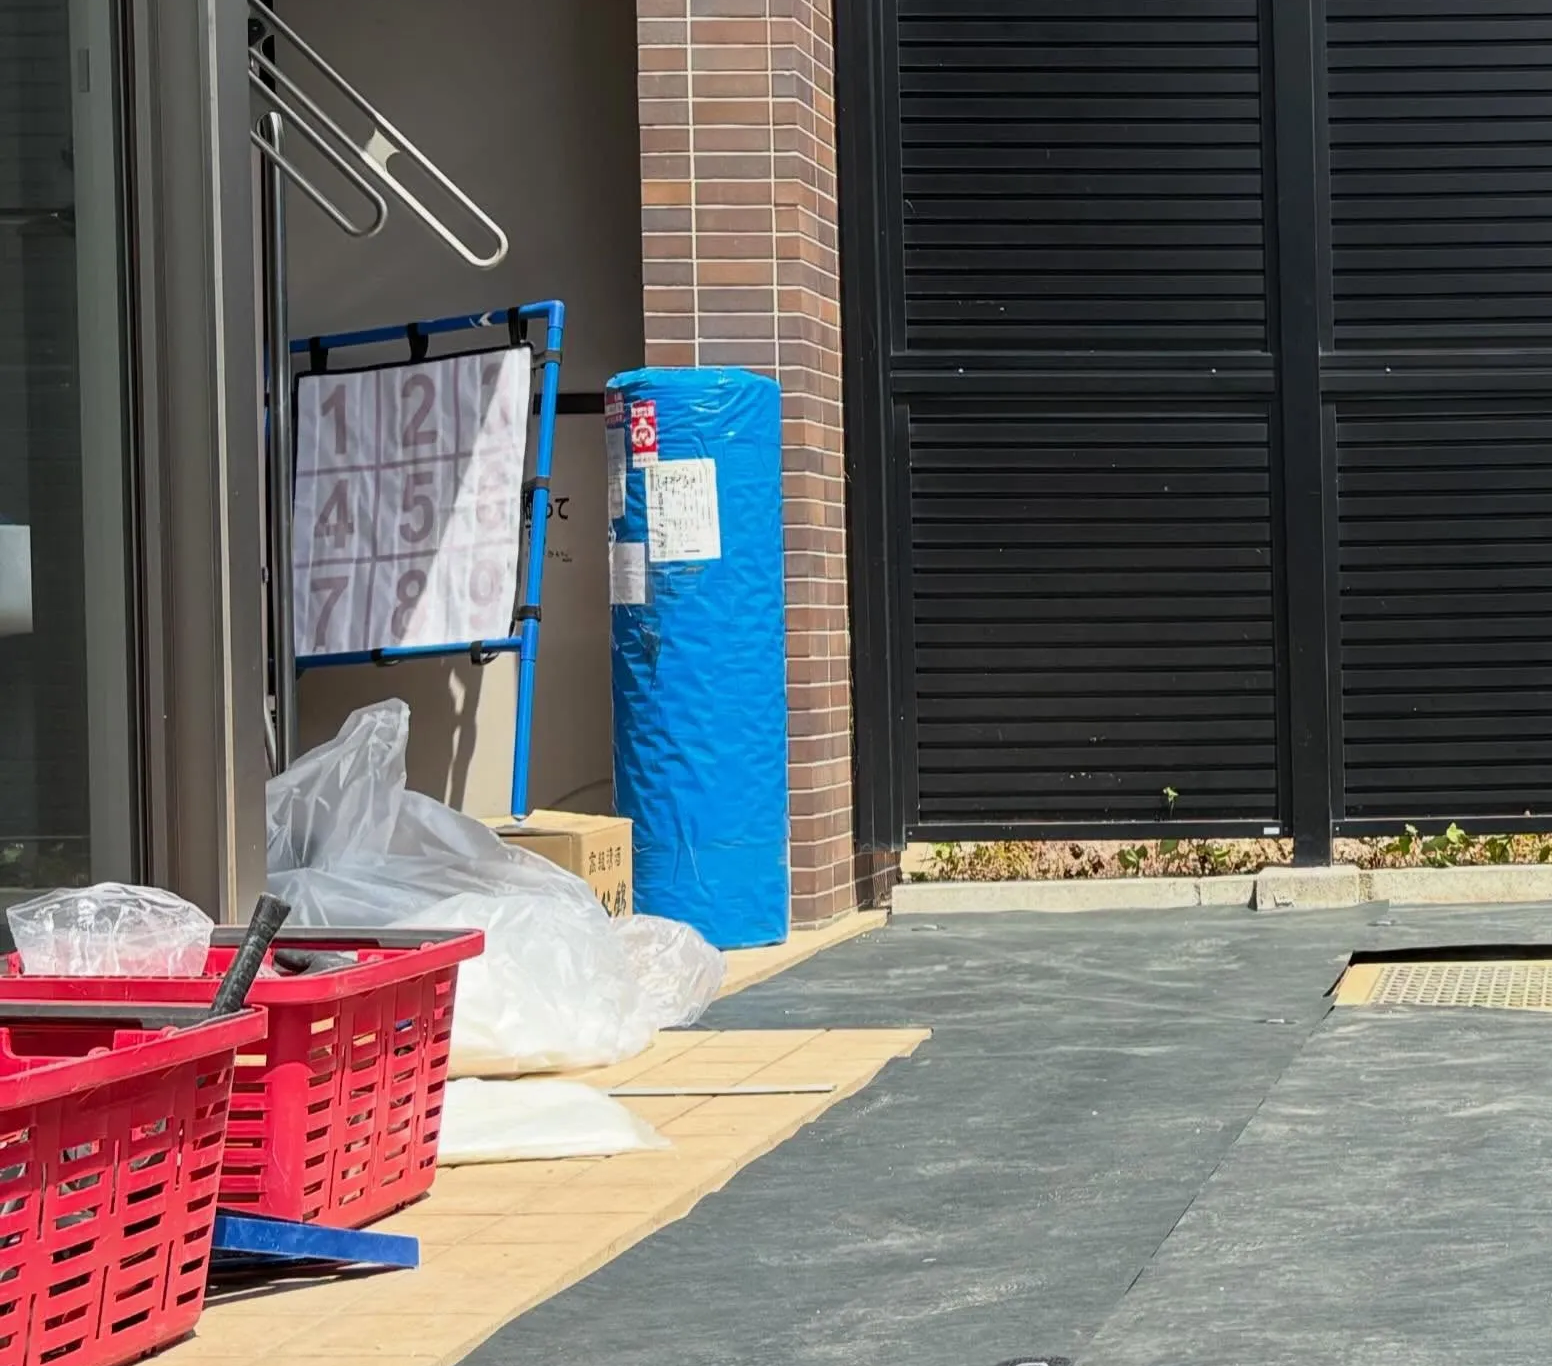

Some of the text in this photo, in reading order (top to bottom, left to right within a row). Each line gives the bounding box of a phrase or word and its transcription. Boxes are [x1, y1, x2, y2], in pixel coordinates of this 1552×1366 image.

[321, 384, 347, 455] 1
[401, 373, 438, 448] 2
[314, 479, 354, 549] 4
[399, 471, 434, 543] 5
[310, 576, 349, 649] 7
[391, 569, 428, 642] 8
